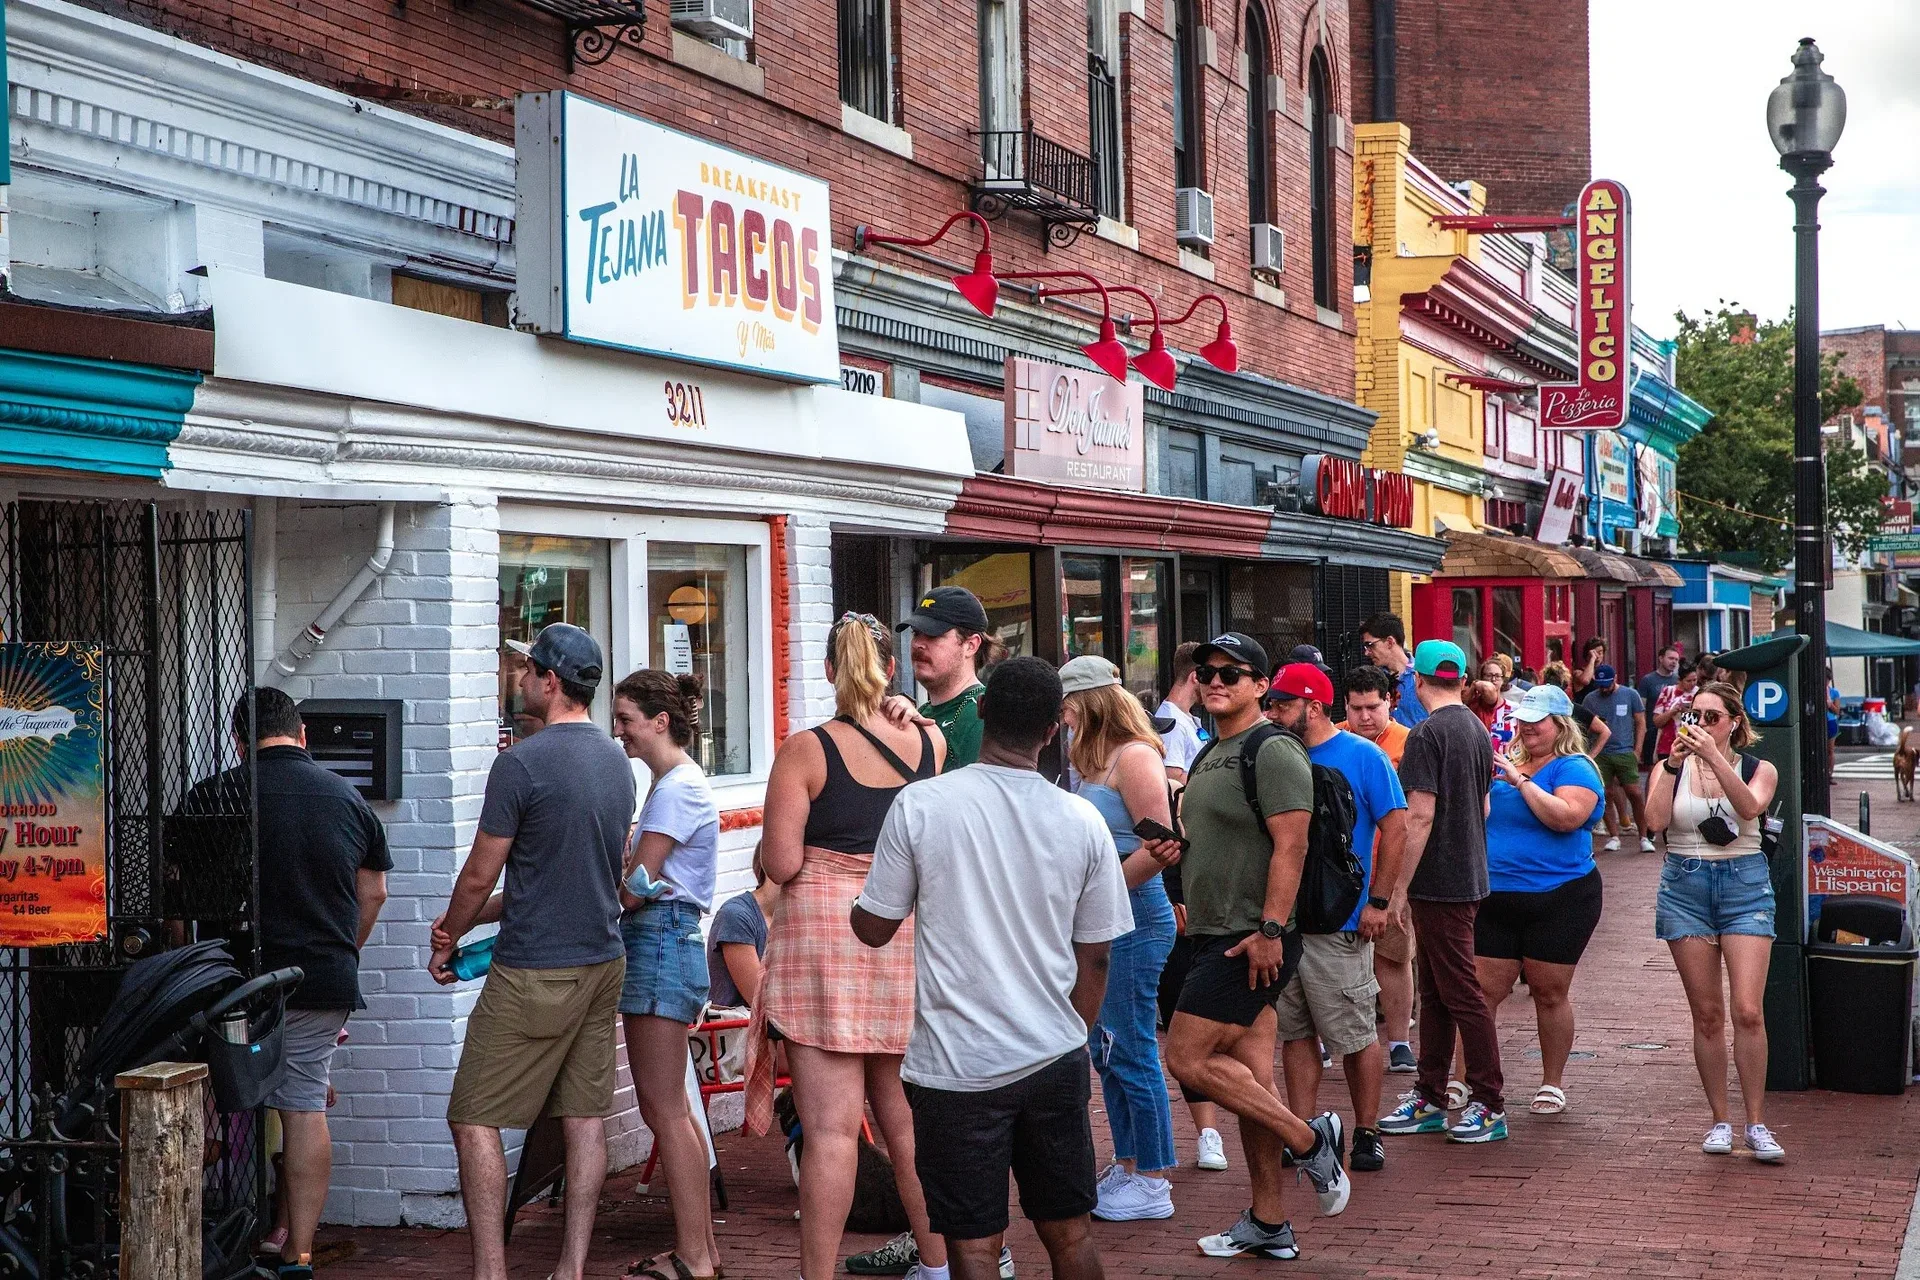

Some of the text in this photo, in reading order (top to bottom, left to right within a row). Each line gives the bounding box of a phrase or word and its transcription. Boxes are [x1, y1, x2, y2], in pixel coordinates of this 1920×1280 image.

[619, 153, 640, 204] LA
[700, 162, 801, 212] BREAKFAST
[579, 201, 668, 304] TEJANA
[672, 189, 822, 336] TACOS
[1585, 188, 1617, 383] ANGELICO
[664, 380, 707, 430] 3211
[1545, 391, 1618, 420] Pizzeria
[1575, 387, 1591, 401] La
[1066, 461, 1132, 480] RESTAURANT
[1757, 681, 1783, 718] P
[16, 714, 69, 736] Taqueria
[14, 821, 80, 847] Hour
[23, 855, 84, 879] 4-7pm
[1812, 864, 1902, 880] Washington
[1814, 876, 1902, 894] Hispanic
[13, 904, 51, 916] $4 Beer
